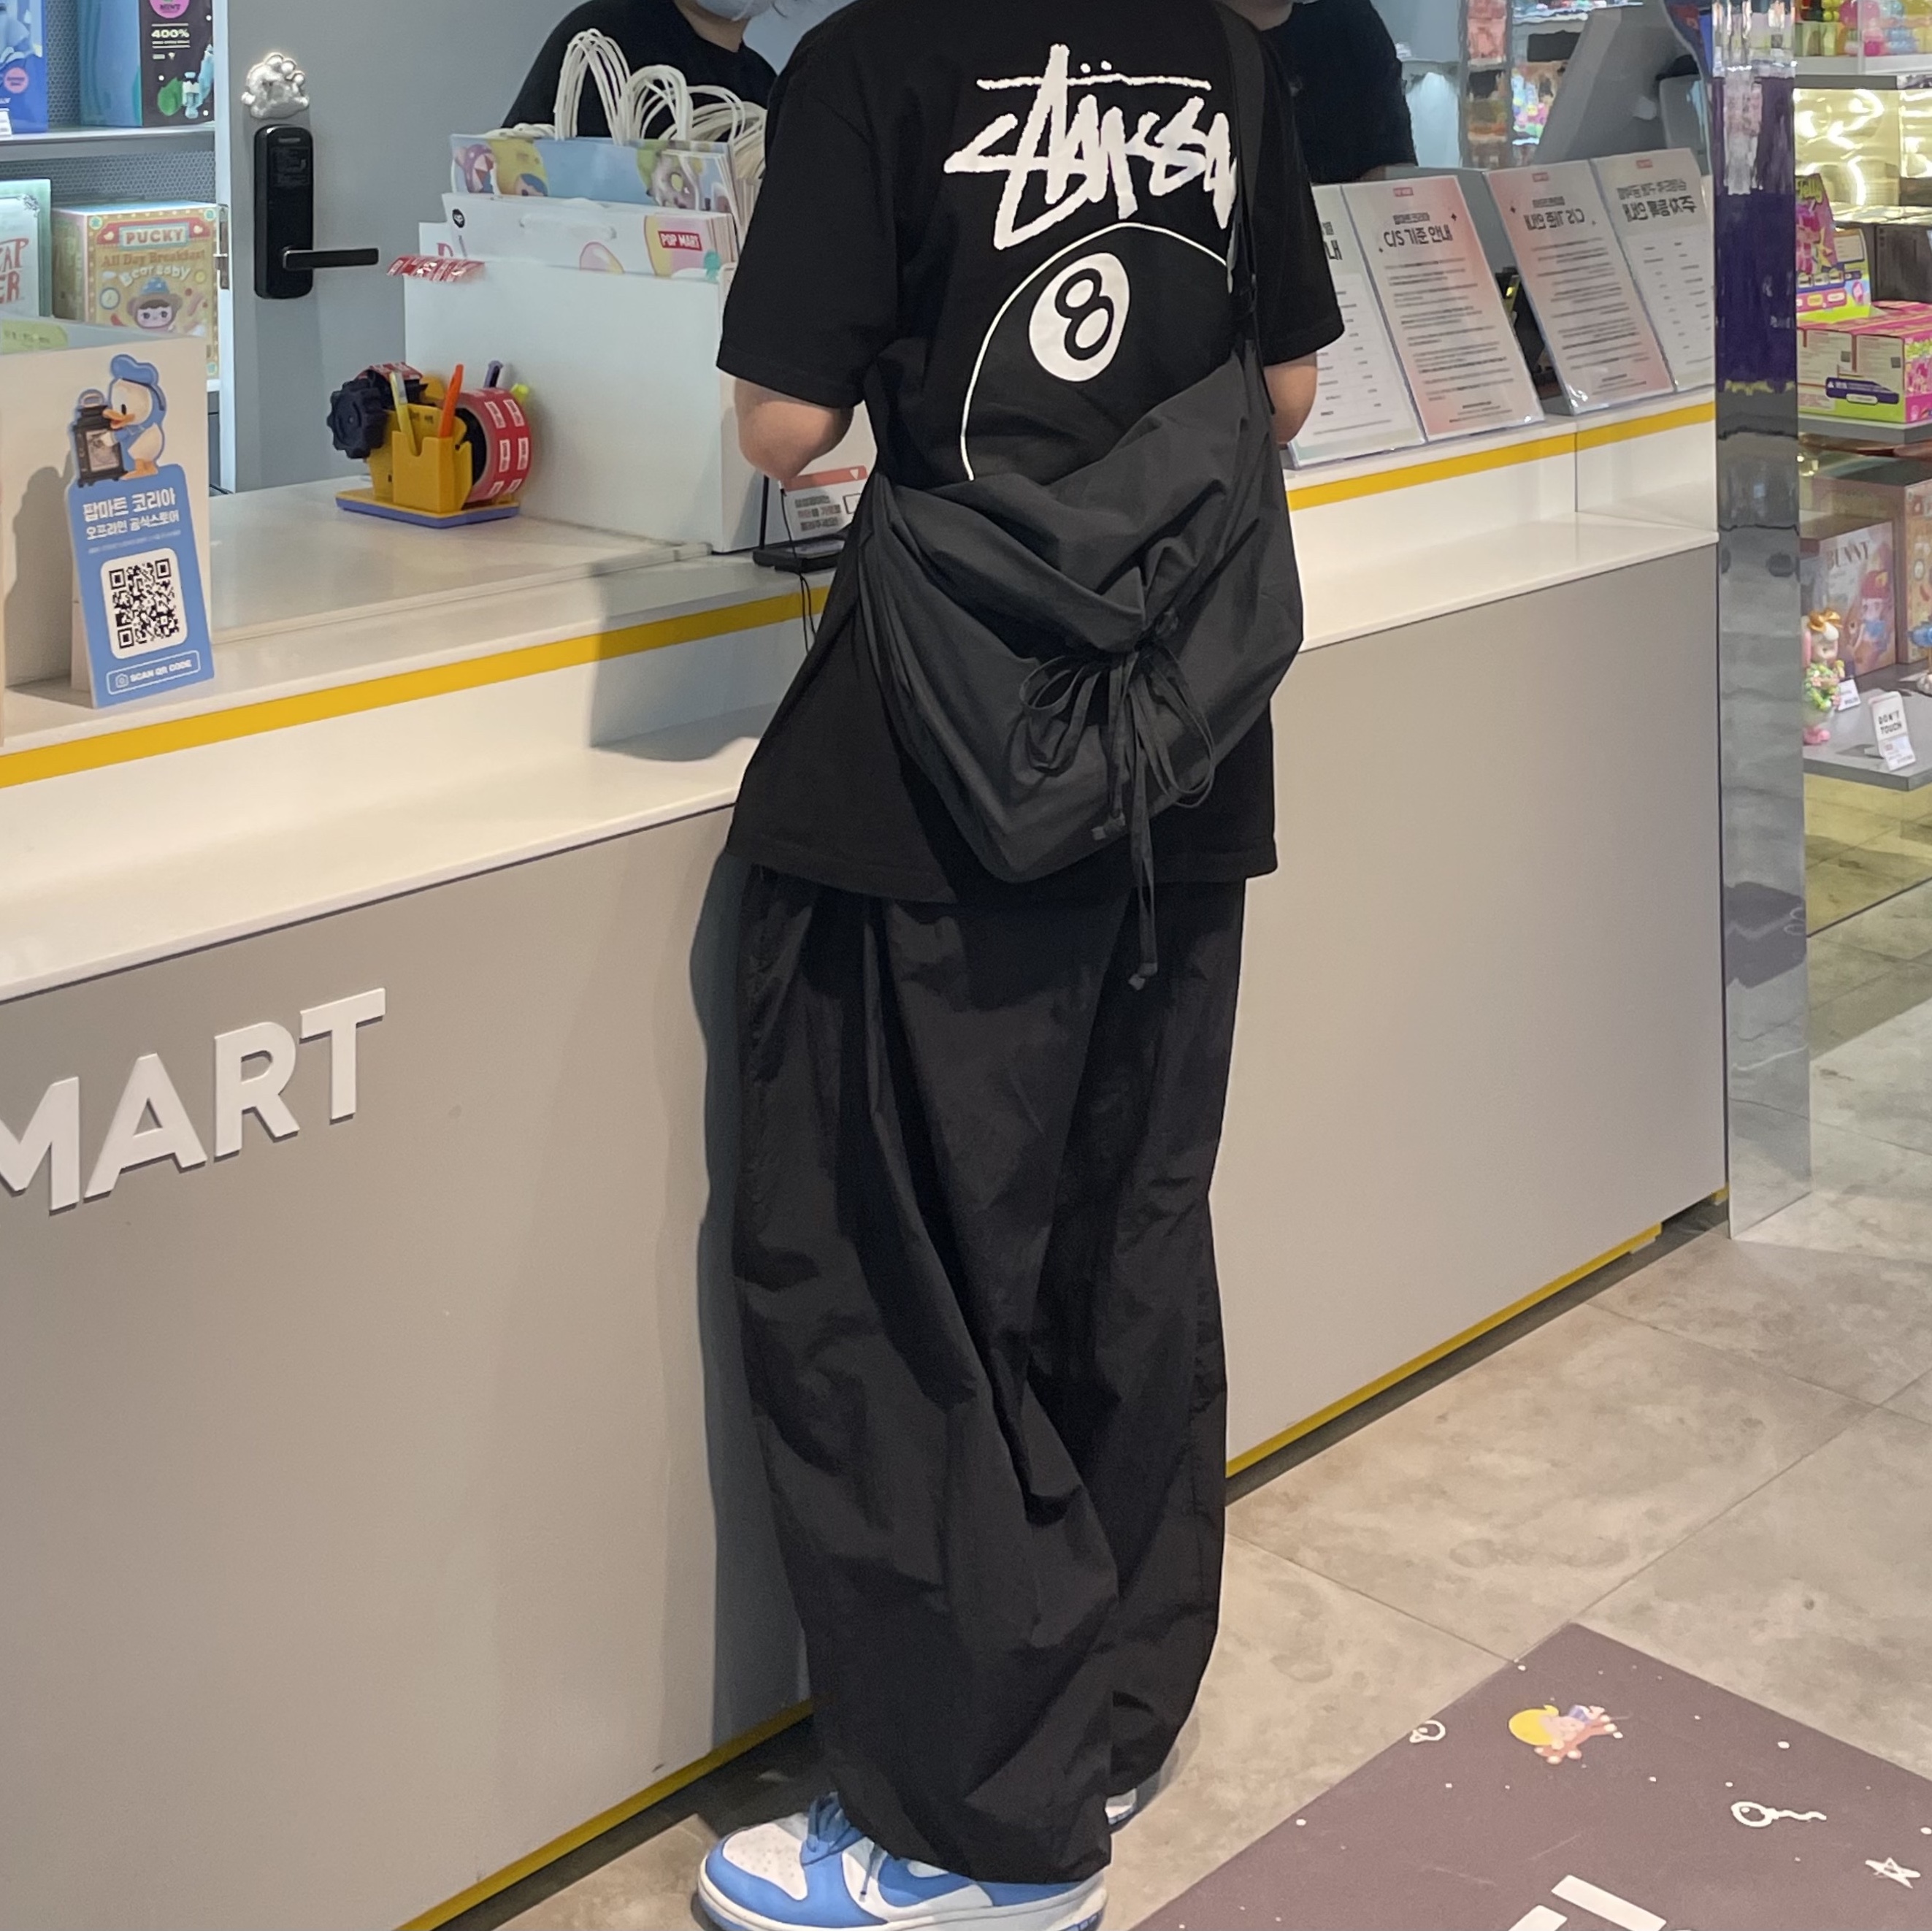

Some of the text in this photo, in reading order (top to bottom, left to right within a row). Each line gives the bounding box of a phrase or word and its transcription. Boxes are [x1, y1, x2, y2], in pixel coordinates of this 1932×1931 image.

[151, 28, 190, 39] 400%
[126, 229, 183, 245] PUCKY
[661, 234, 678, 246] POP
[1384, 224, 1453, 248] CIS 기준 안내
[101, 253, 121, 267] All
[123, 253, 145, 267] Day
[1055, 268, 1114, 361] 8
[83, 487, 175, 522] 팝마트 코리아
[87, 510, 180, 540] 오프라인 공식스토어
[130, 659, 193, 682] SCAN QR CODE
[1879, 710, 1900, 724] DON'T
[1880, 722, 1902, 734] TOUCH
